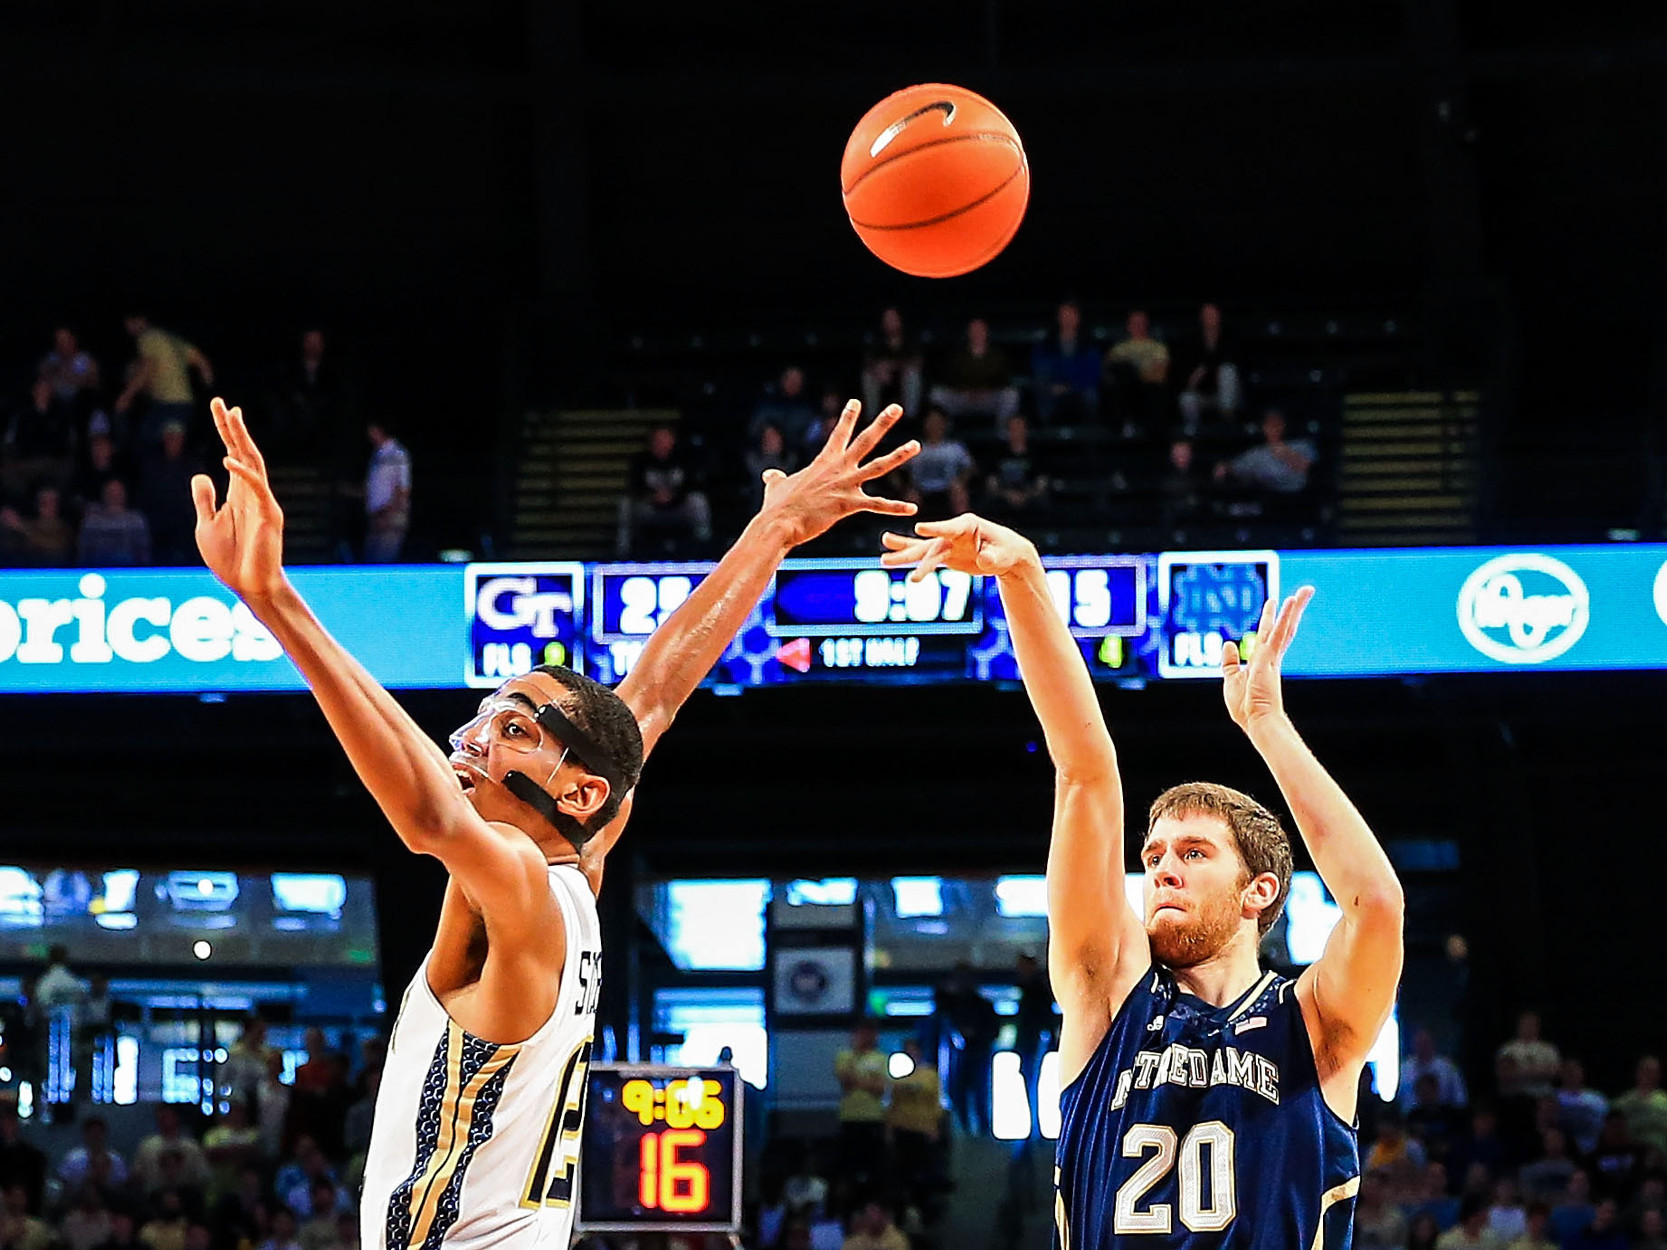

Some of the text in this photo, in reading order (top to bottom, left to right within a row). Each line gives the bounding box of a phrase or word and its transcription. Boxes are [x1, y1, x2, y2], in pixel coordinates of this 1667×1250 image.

[0, 573, 285, 663] rices
[477, 576, 572, 637] GT
[1188, 1047, 1280, 1105] DAME
[639, 1129, 709, 1213] 16
[1114, 1120, 1237, 1235] 20
